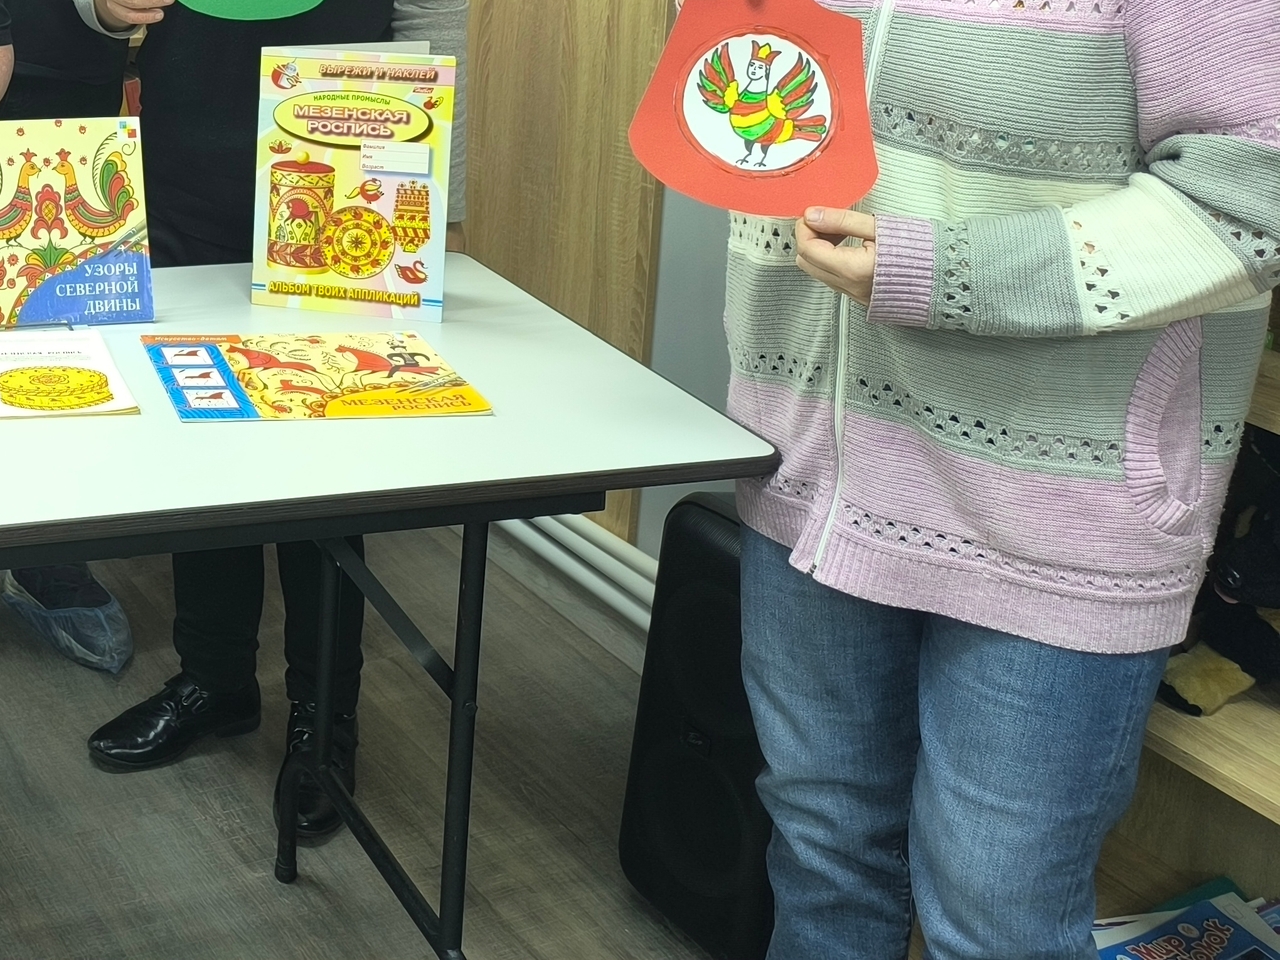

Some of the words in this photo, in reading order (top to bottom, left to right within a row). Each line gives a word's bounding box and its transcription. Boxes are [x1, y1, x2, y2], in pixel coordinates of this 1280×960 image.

[319, 64, 371, 77] ВЫРЕЖИ
[375, 67, 384, 77] И
[386, 67, 436, 81] НАКЛЕЙ
[313, 94, 350, 102] НАРОДНЫЕ
[351, 95, 391, 105] ПРОМЫСЛЫ
[293, 104, 409, 123] МЕЗЕНСКАЯ
[307, 120, 393, 137] РОСПИСЬ
[84, 262, 138, 277] УЗОРЫ
[56, 276, 139, 297] СЕВЕРНОЙ
[268, 281, 310, 294] АЛЬБОМ
[312, 284, 345, 298] ТВОИХ
[348, 288, 419, 306] АППЛИКАЦИЙ
[84, 298, 140, 315] ДВИНЫ
[340, 394, 467, 407] МЕЗЕНСКАЯ
[392, 401, 472, 411] РОСПИСЬ
